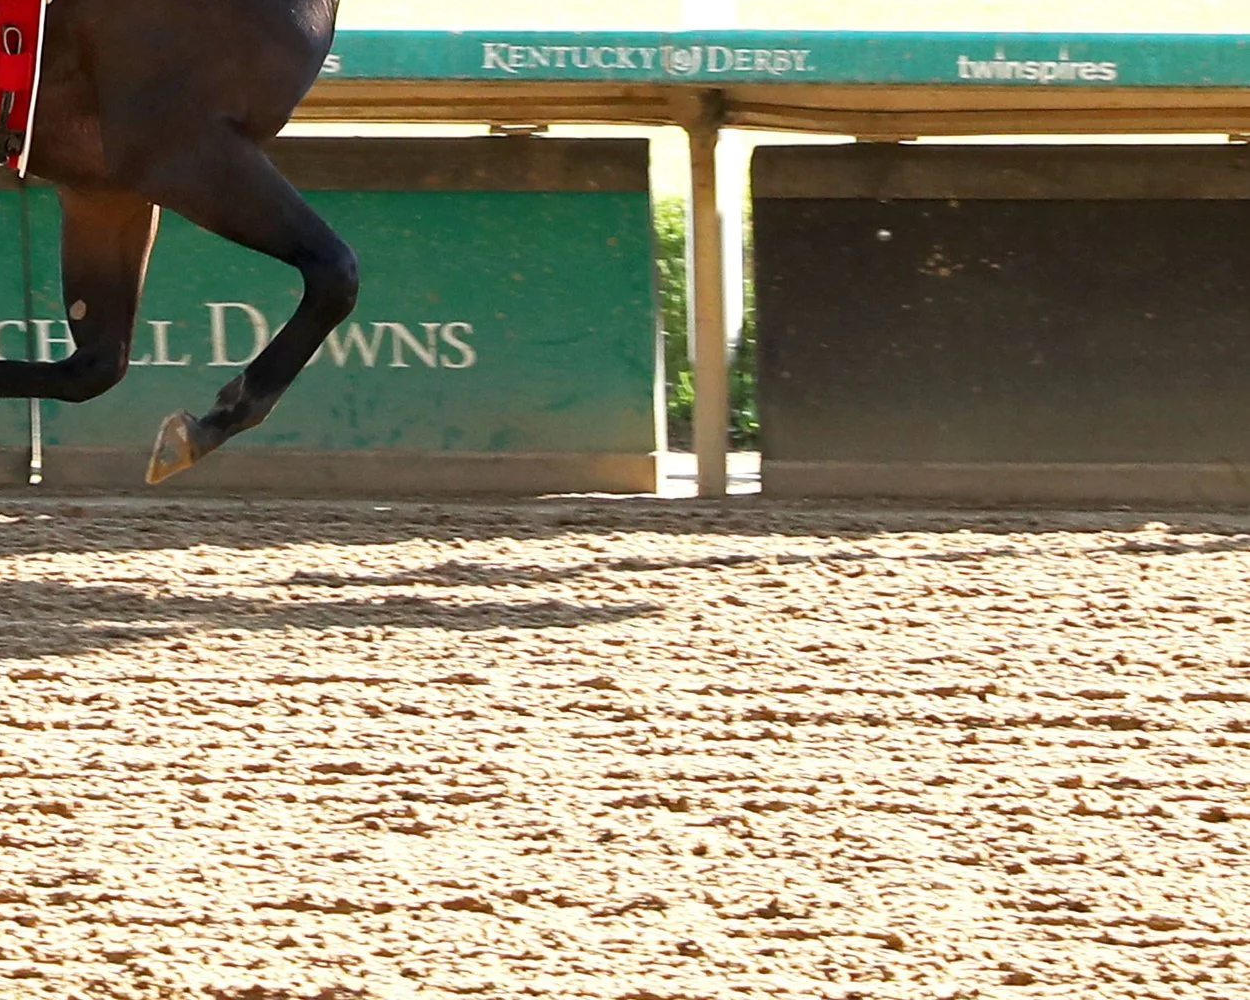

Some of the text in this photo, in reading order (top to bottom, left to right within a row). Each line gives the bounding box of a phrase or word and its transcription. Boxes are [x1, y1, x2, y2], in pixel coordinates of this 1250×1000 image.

[481, 43, 812, 75] KENTUCKY DERBY
[956, 46, 1118, 84] twinspires
[205, 302, 477, 369] DWNS
